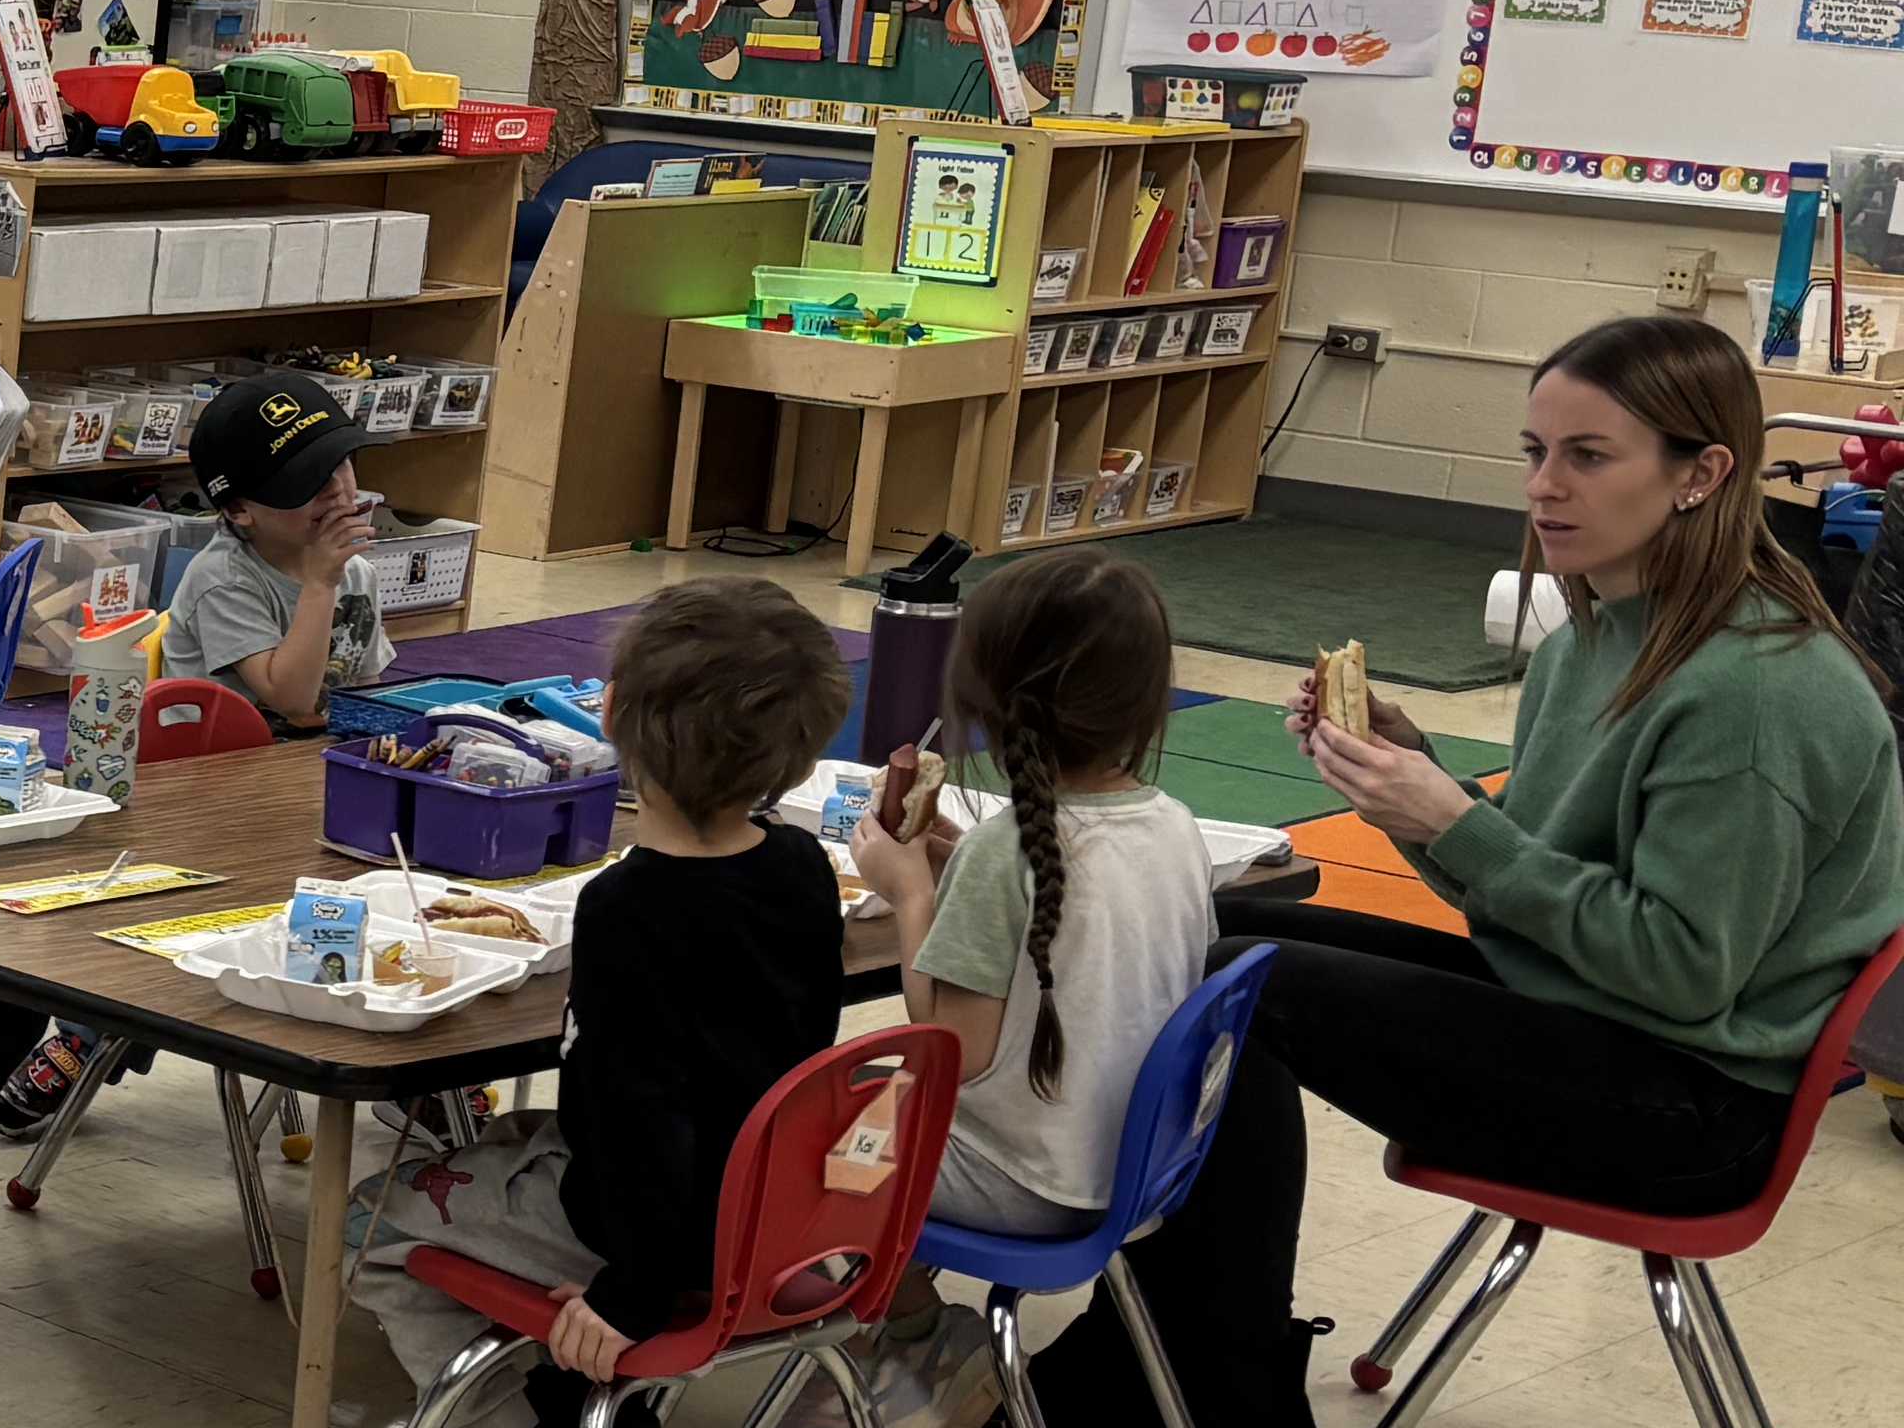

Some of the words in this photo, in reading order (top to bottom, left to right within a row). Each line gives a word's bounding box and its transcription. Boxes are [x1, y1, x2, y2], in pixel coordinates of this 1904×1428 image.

[926, 231, 931, 257] 1
[958, 233, 978, 262] 2
[270, 429, 298, 454] JOHN
